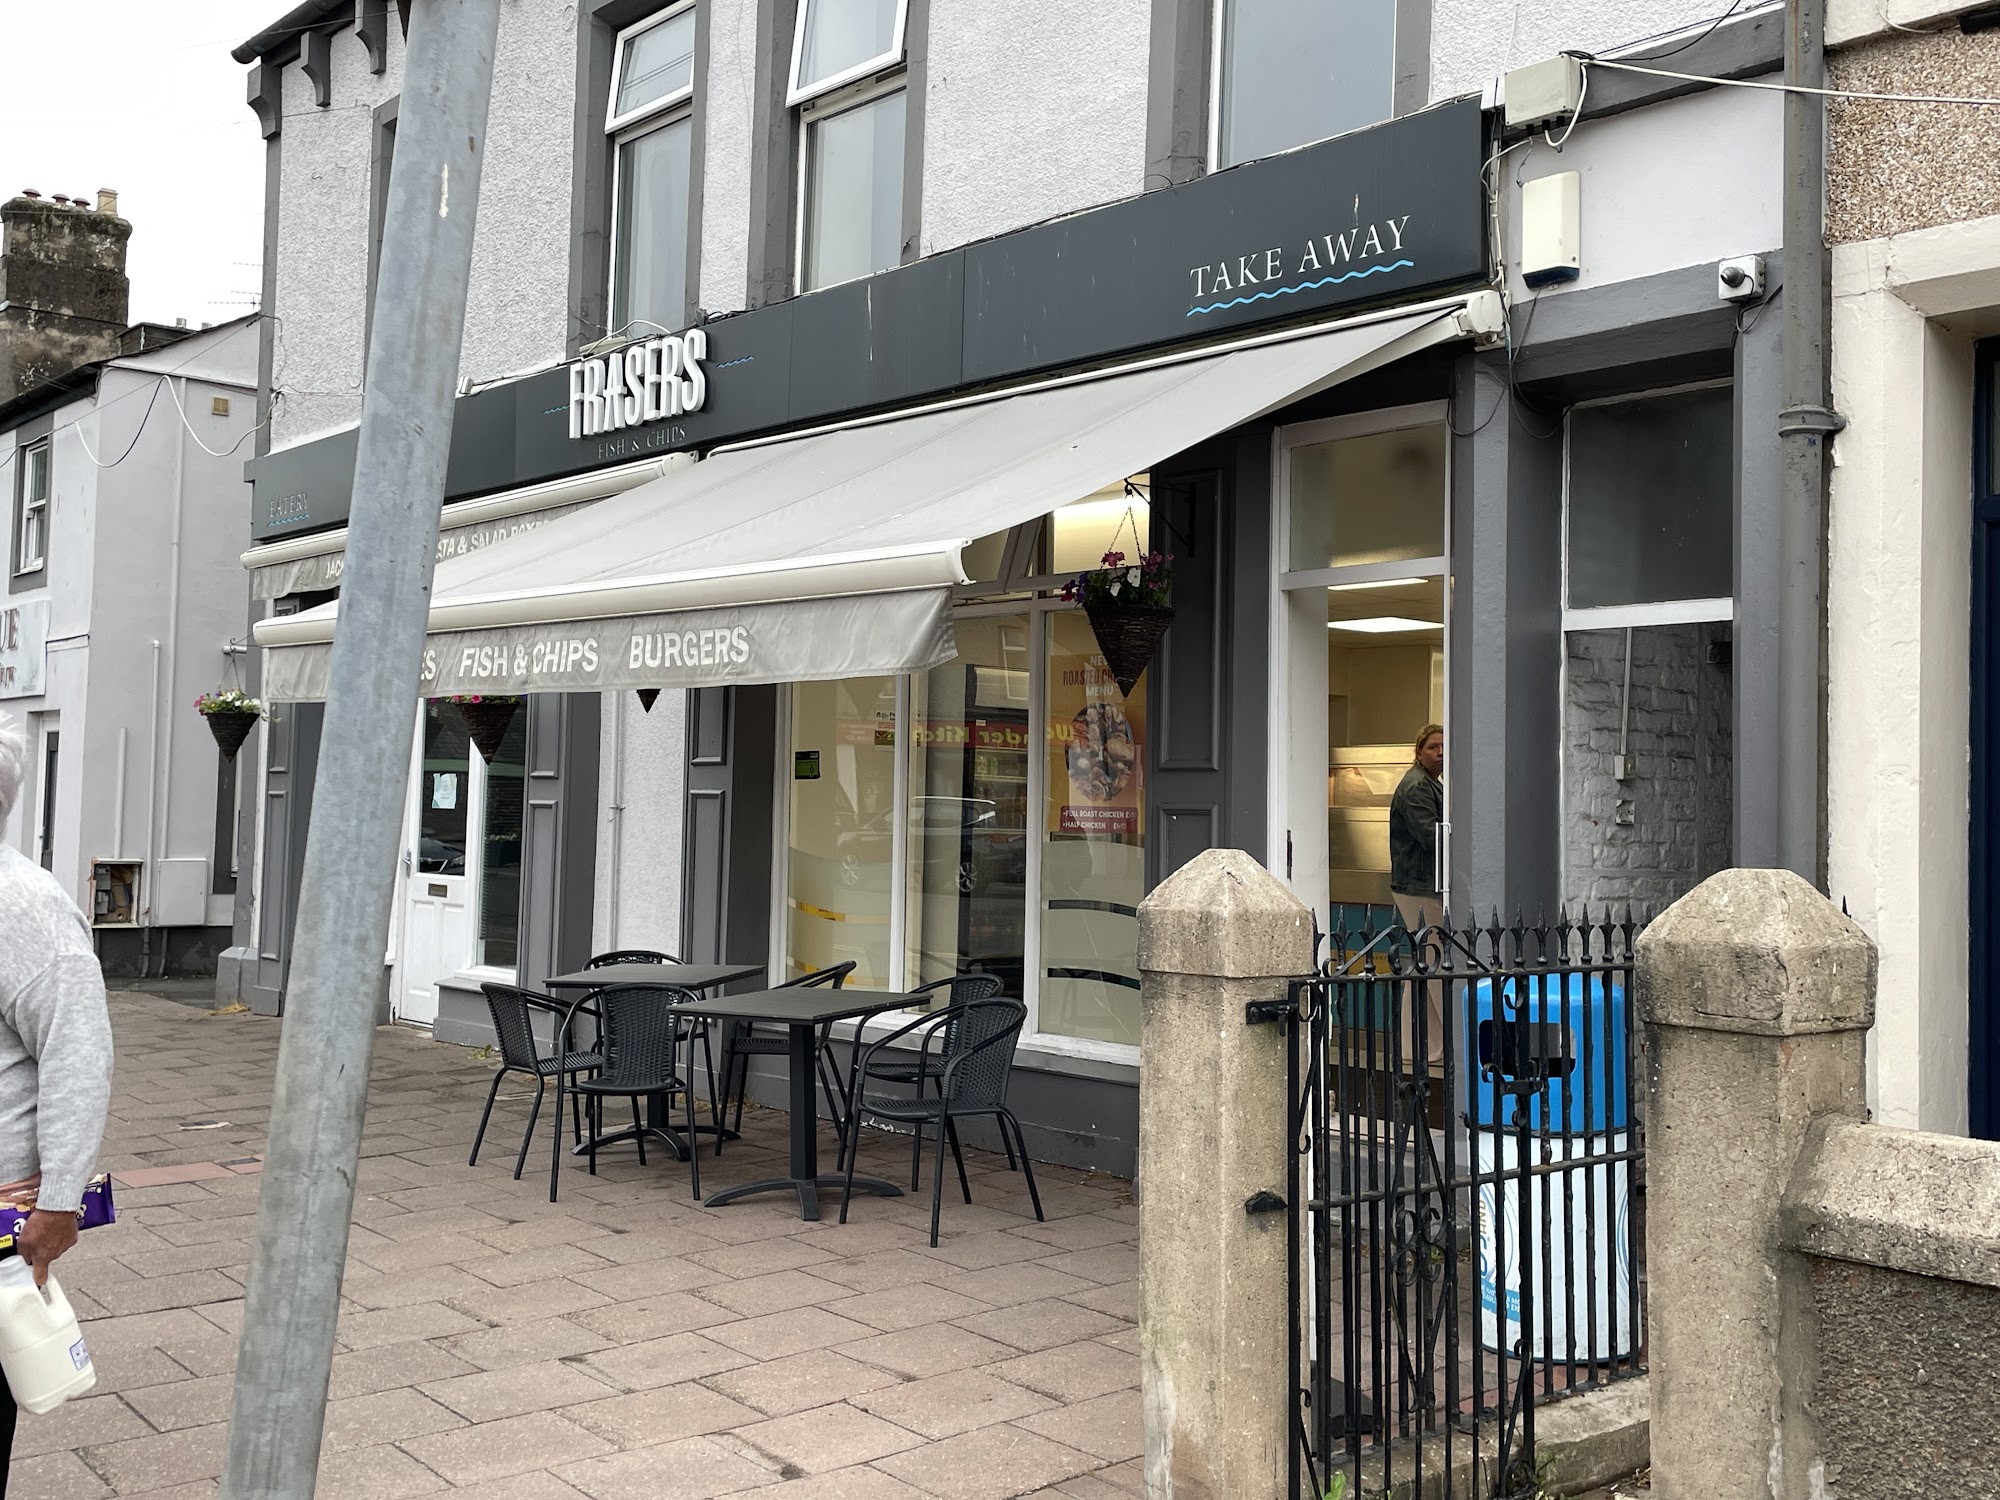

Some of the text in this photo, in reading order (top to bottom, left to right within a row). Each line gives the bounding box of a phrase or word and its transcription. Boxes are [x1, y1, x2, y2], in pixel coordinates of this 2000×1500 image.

[1189, 214, 1411, 298] TAKE AWAY
[569, 328, 707, 440] FRASERS
[598, 424, 686, 459] FISH & CHIPS
[269, 490, 308, 518] EATERY
[458, 646, 508, 677] FISH
[514, 643, 528, 675] &
[532, 637, 599, 674] CHIPS
[629, 625, 750, 669] BURGERS
[1063, 668, 1100, 686] ROASTED
[1086, 685, 1114, 697] MENU
[1080, 810, 1098, 818] ROAST
[1098, 811, 1124, 819] CHICKEN
[1080, 821, 1106, 829] CHICKEN
